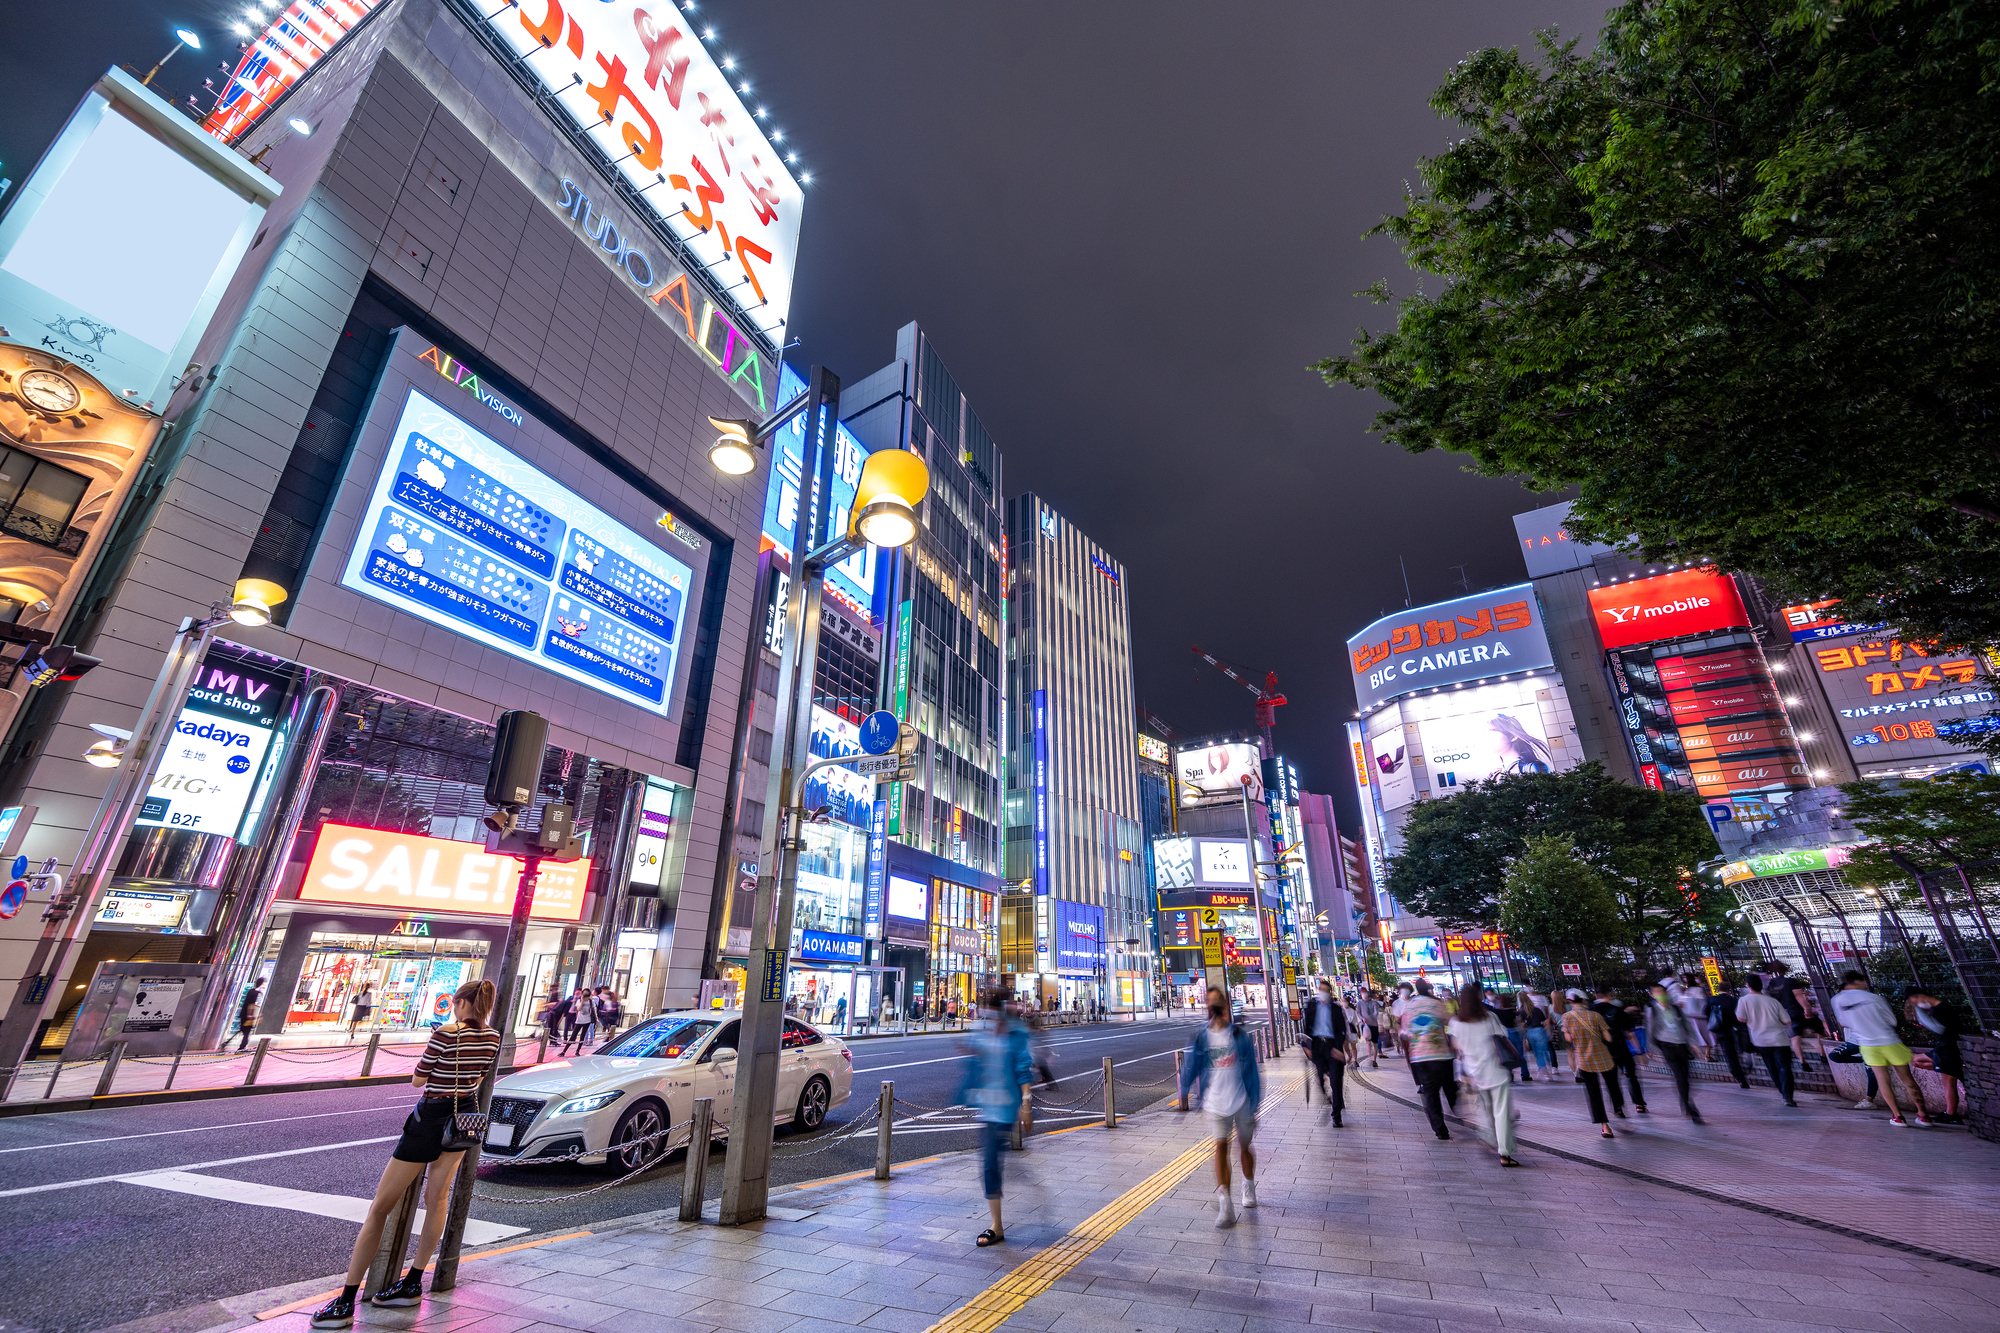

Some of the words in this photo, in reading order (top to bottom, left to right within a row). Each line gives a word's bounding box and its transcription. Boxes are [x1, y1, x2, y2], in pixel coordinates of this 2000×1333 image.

[558, 178, 653, 287] STUDIO
[651, 274, 766, 412] ALTA
[1525, 530, 1568, 549] TAK
[1092, 554, 1119, 581] MIZUHO
[1602, 605, 1642, 625] Y!
[1644, 595, 1711, 618] mobile
[838, 616, 875, 654] アオキ
[1353, 600, 1531, 673] ビックカメラ
[1814, 623, 1866, 637] マルチメ
[1370, 665, 1397, 689] BIC
[1401, 641, 1511, 674] CAMERA
[1865, 659, 1976, 695] カメラ
[224, 697, 261, 714] shop
[260, 717, 273, 726] 6F
[1685, 738, 1708, 746] au
[1727, 732, 1754, 742] au
[181, 749, 207, 761] 生地
[1433, 753, 1470, 764] oppo
[860, 758, 897, 773] 歩行者優先
[1185, 767, 1204, 780] Spa
[1698, 774, 1720, 782] au
[1738, 768, 1769, 780] au
[171, 813, 201, 827] B2F
[1706, 805, 1732, 833] P
[1370, 837, 1379, 852] BIC
[639, 848, 657, 866] glo
[1764, 853, 1815, 870] MEN'S
[322, 839, 512, 904] SALE!
[1212, 895, 1249, 904] ABC-MART
[1204, 909, 1216, 923] 2
[391, 921, 430, 936] ALTA
[1067, 921, 1095, 935] MIZUHO
[803, 938, 846, 953] AOYAMA
[954, 934, 978, 948] GUCCI
[1446, 934, 1500, 951] ビック
